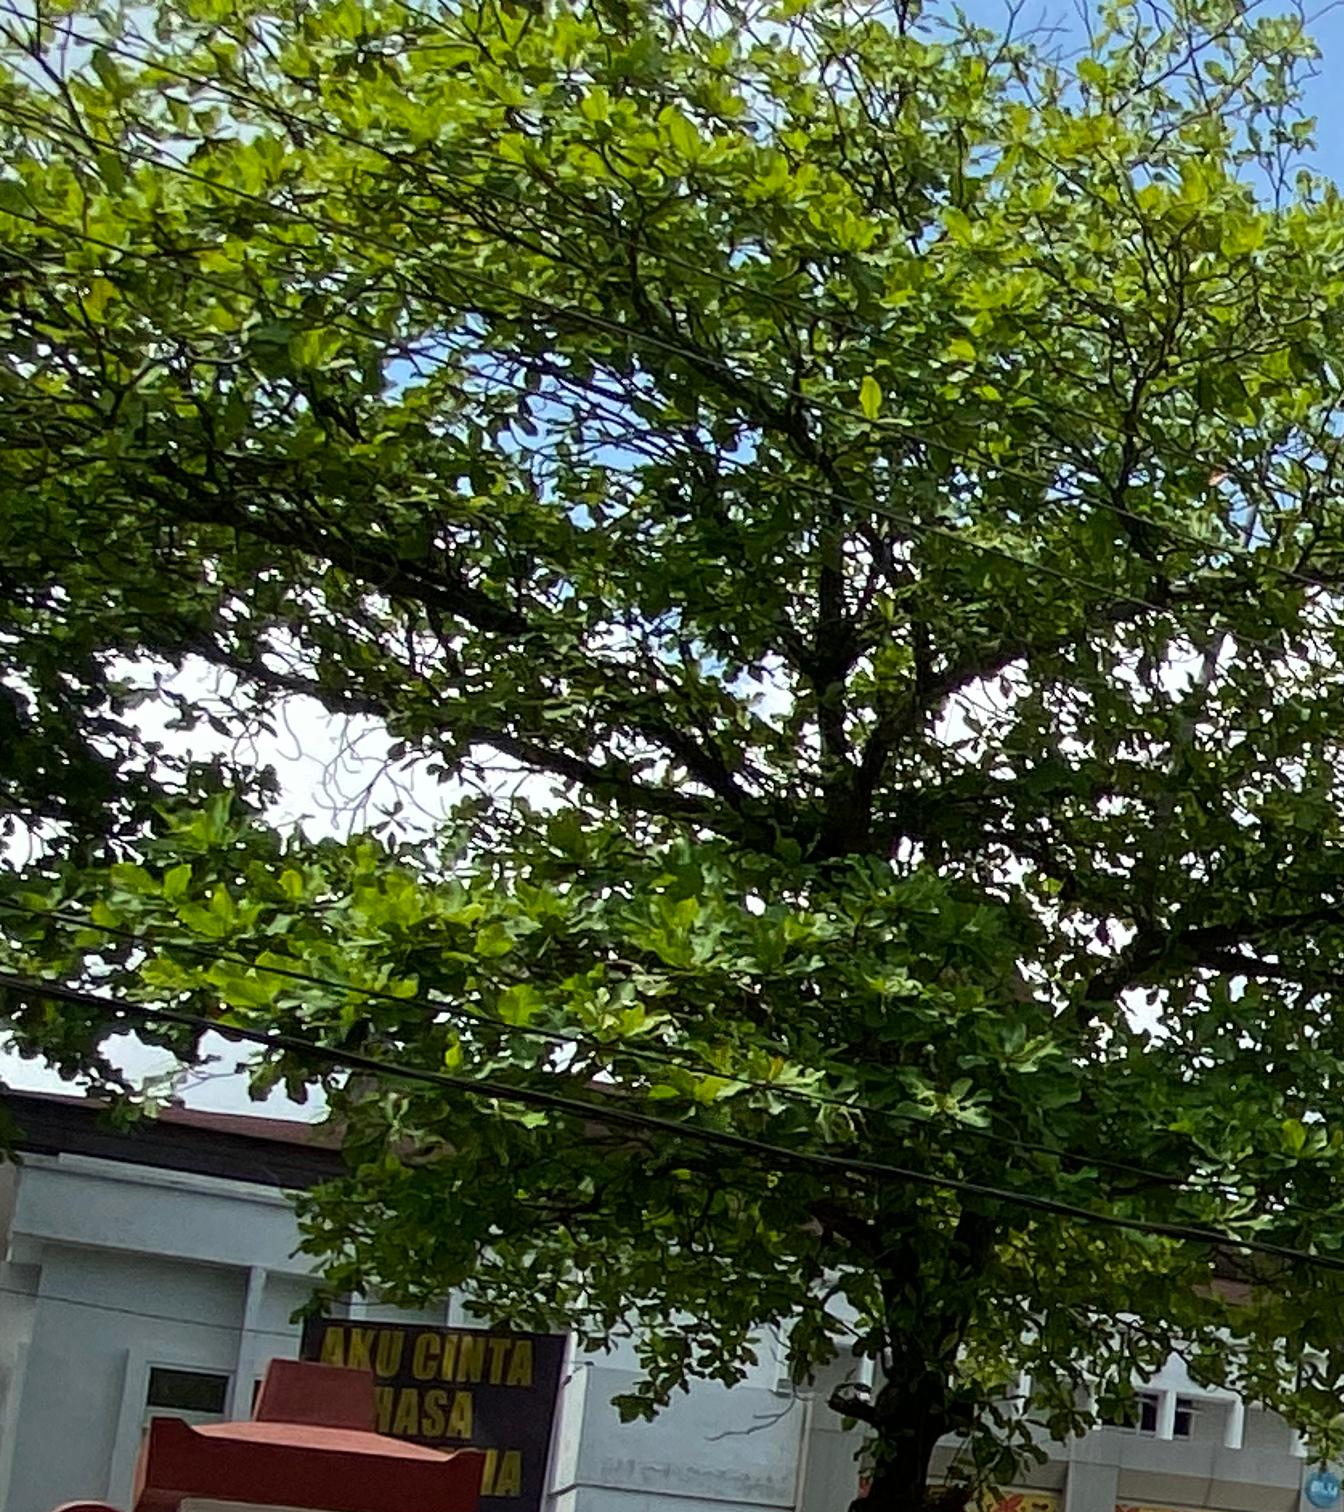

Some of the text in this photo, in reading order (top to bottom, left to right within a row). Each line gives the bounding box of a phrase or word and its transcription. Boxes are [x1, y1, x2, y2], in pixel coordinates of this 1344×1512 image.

[320, 1326, 534, 1388] AKU CINTA
[374, 1386, 474, 1440] HASA
